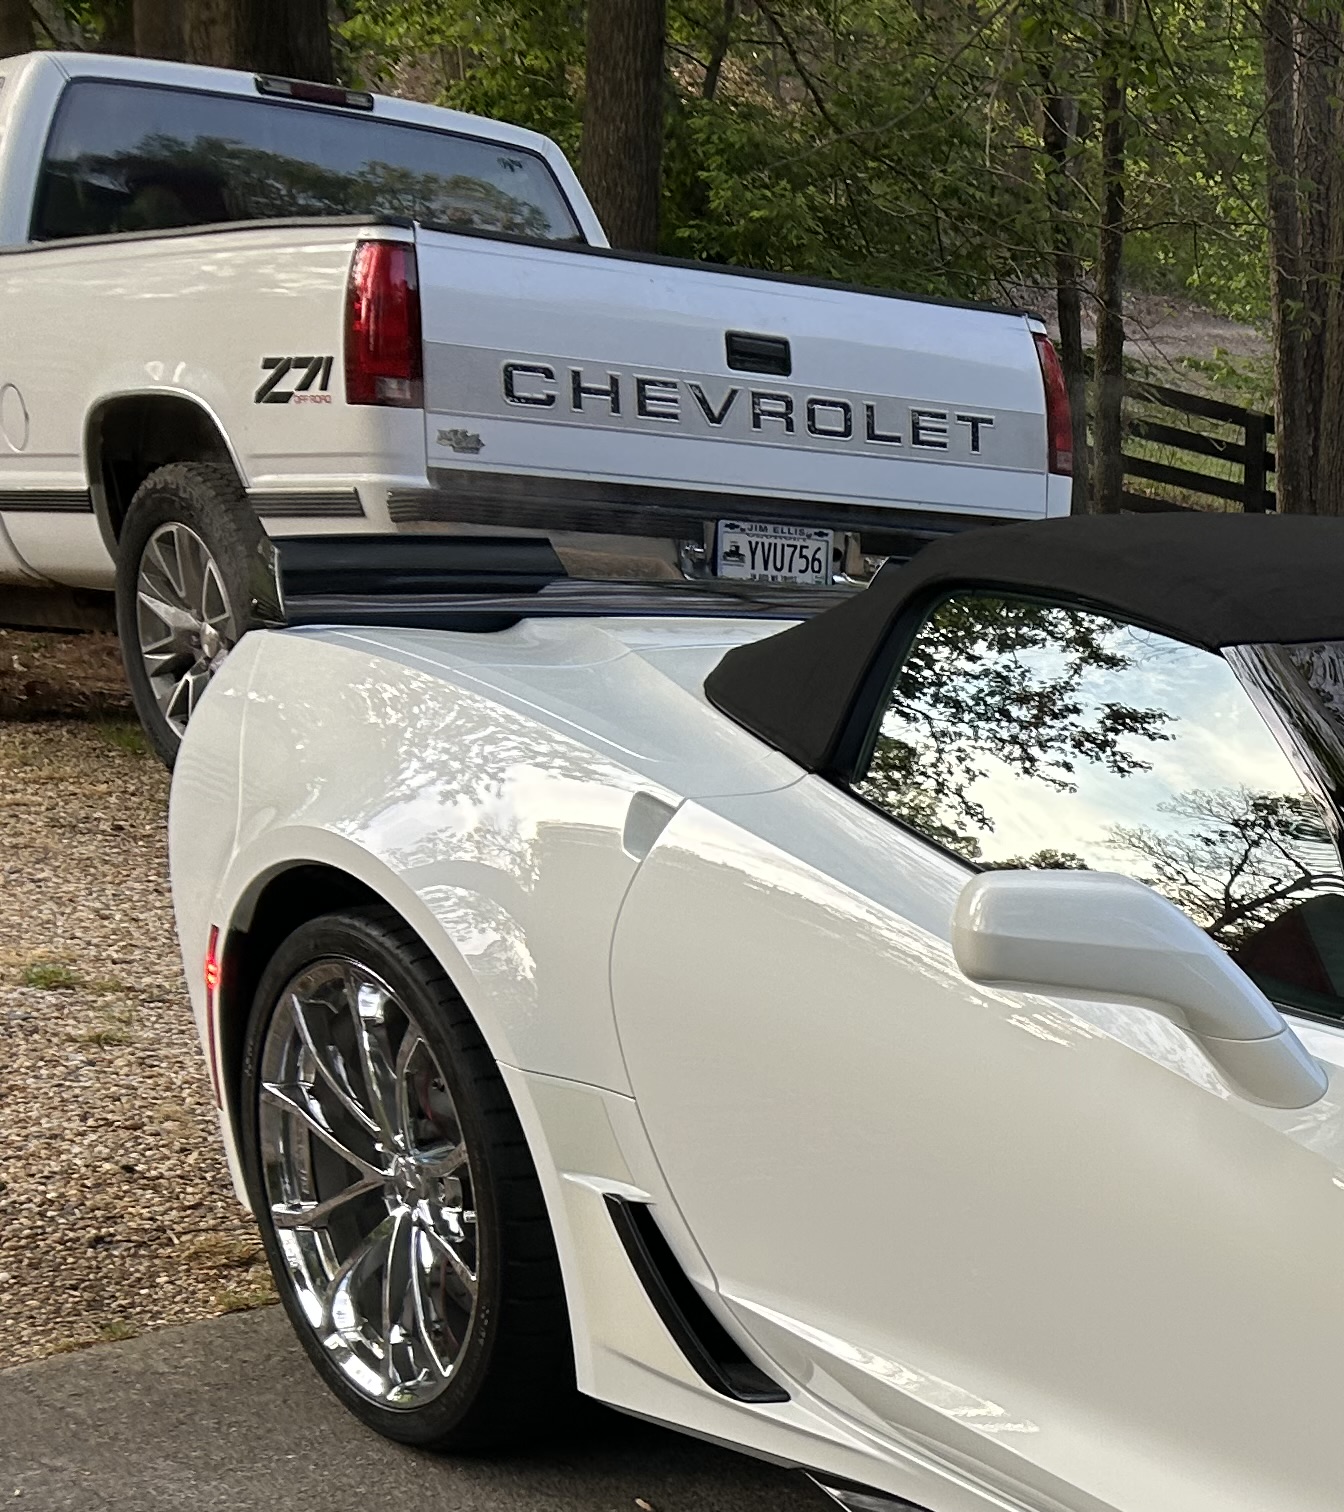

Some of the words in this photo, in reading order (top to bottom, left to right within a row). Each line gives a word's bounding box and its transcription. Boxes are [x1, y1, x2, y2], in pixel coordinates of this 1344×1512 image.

[254, 356, 334, 403] Z71
[502, 359, 996, 455] CHEVROLET
[747, 524, 769, 533] JIM
[773, 526, 806, 537] ELLIS
[748, 540, 823, 575] YVU756
